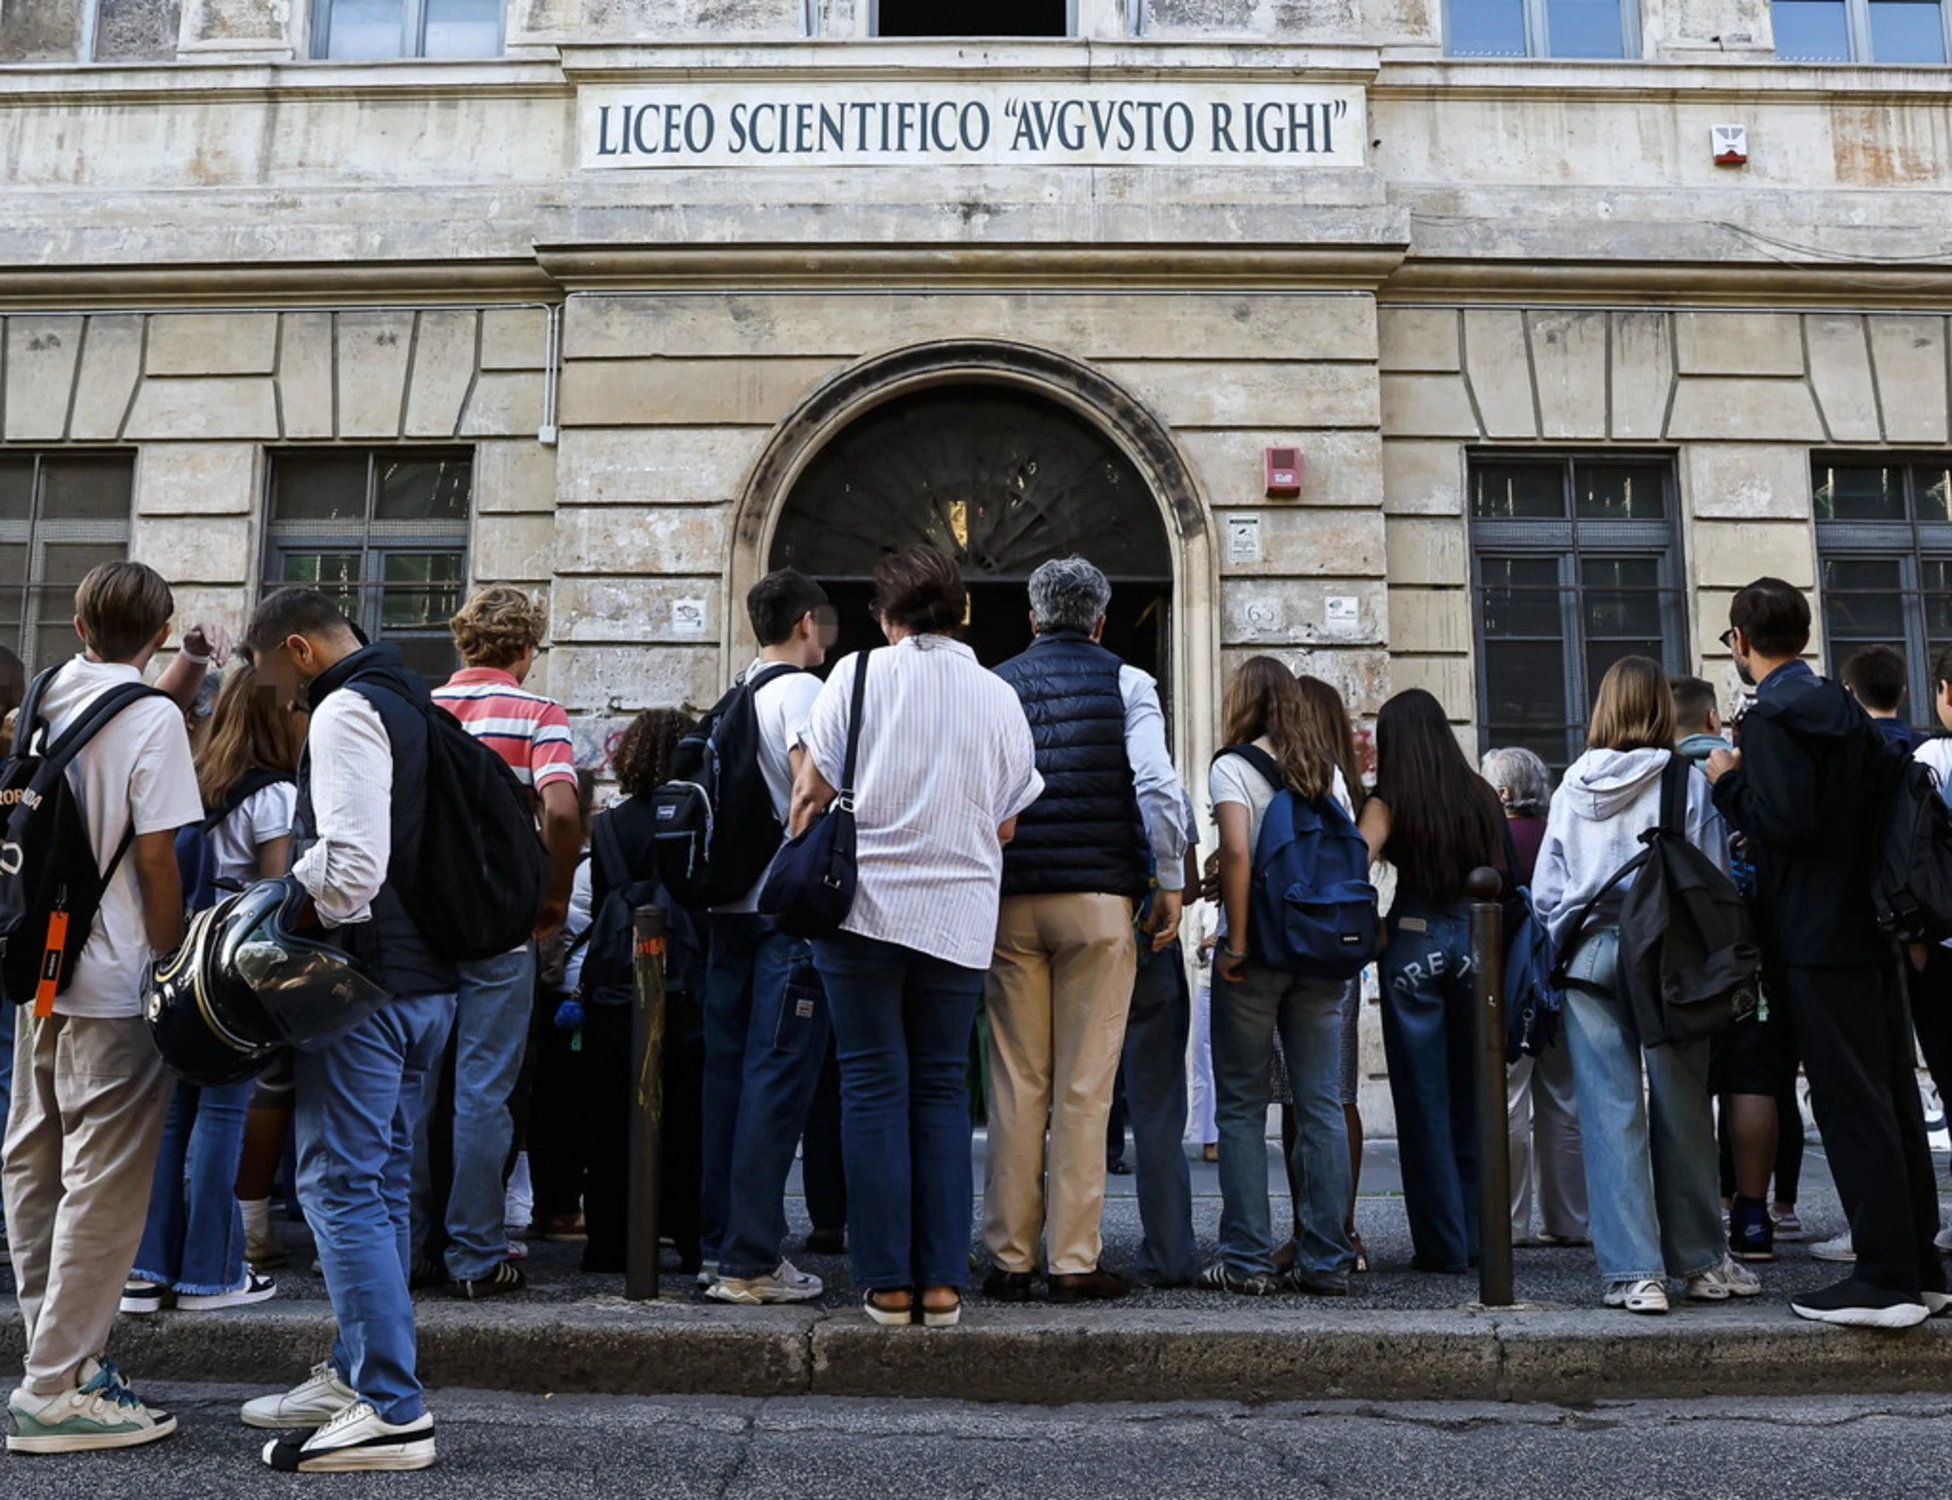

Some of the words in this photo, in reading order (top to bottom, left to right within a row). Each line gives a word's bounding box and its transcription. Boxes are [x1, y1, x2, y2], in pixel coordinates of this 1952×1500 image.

[598, 103, 715, 155] LICEO
[728, 101, 990, 154] SCIENTIFICO
[1004, 100, 1194, 152] “AVGVSTO
[1210, 99, 1347, 153] RIGHI”
